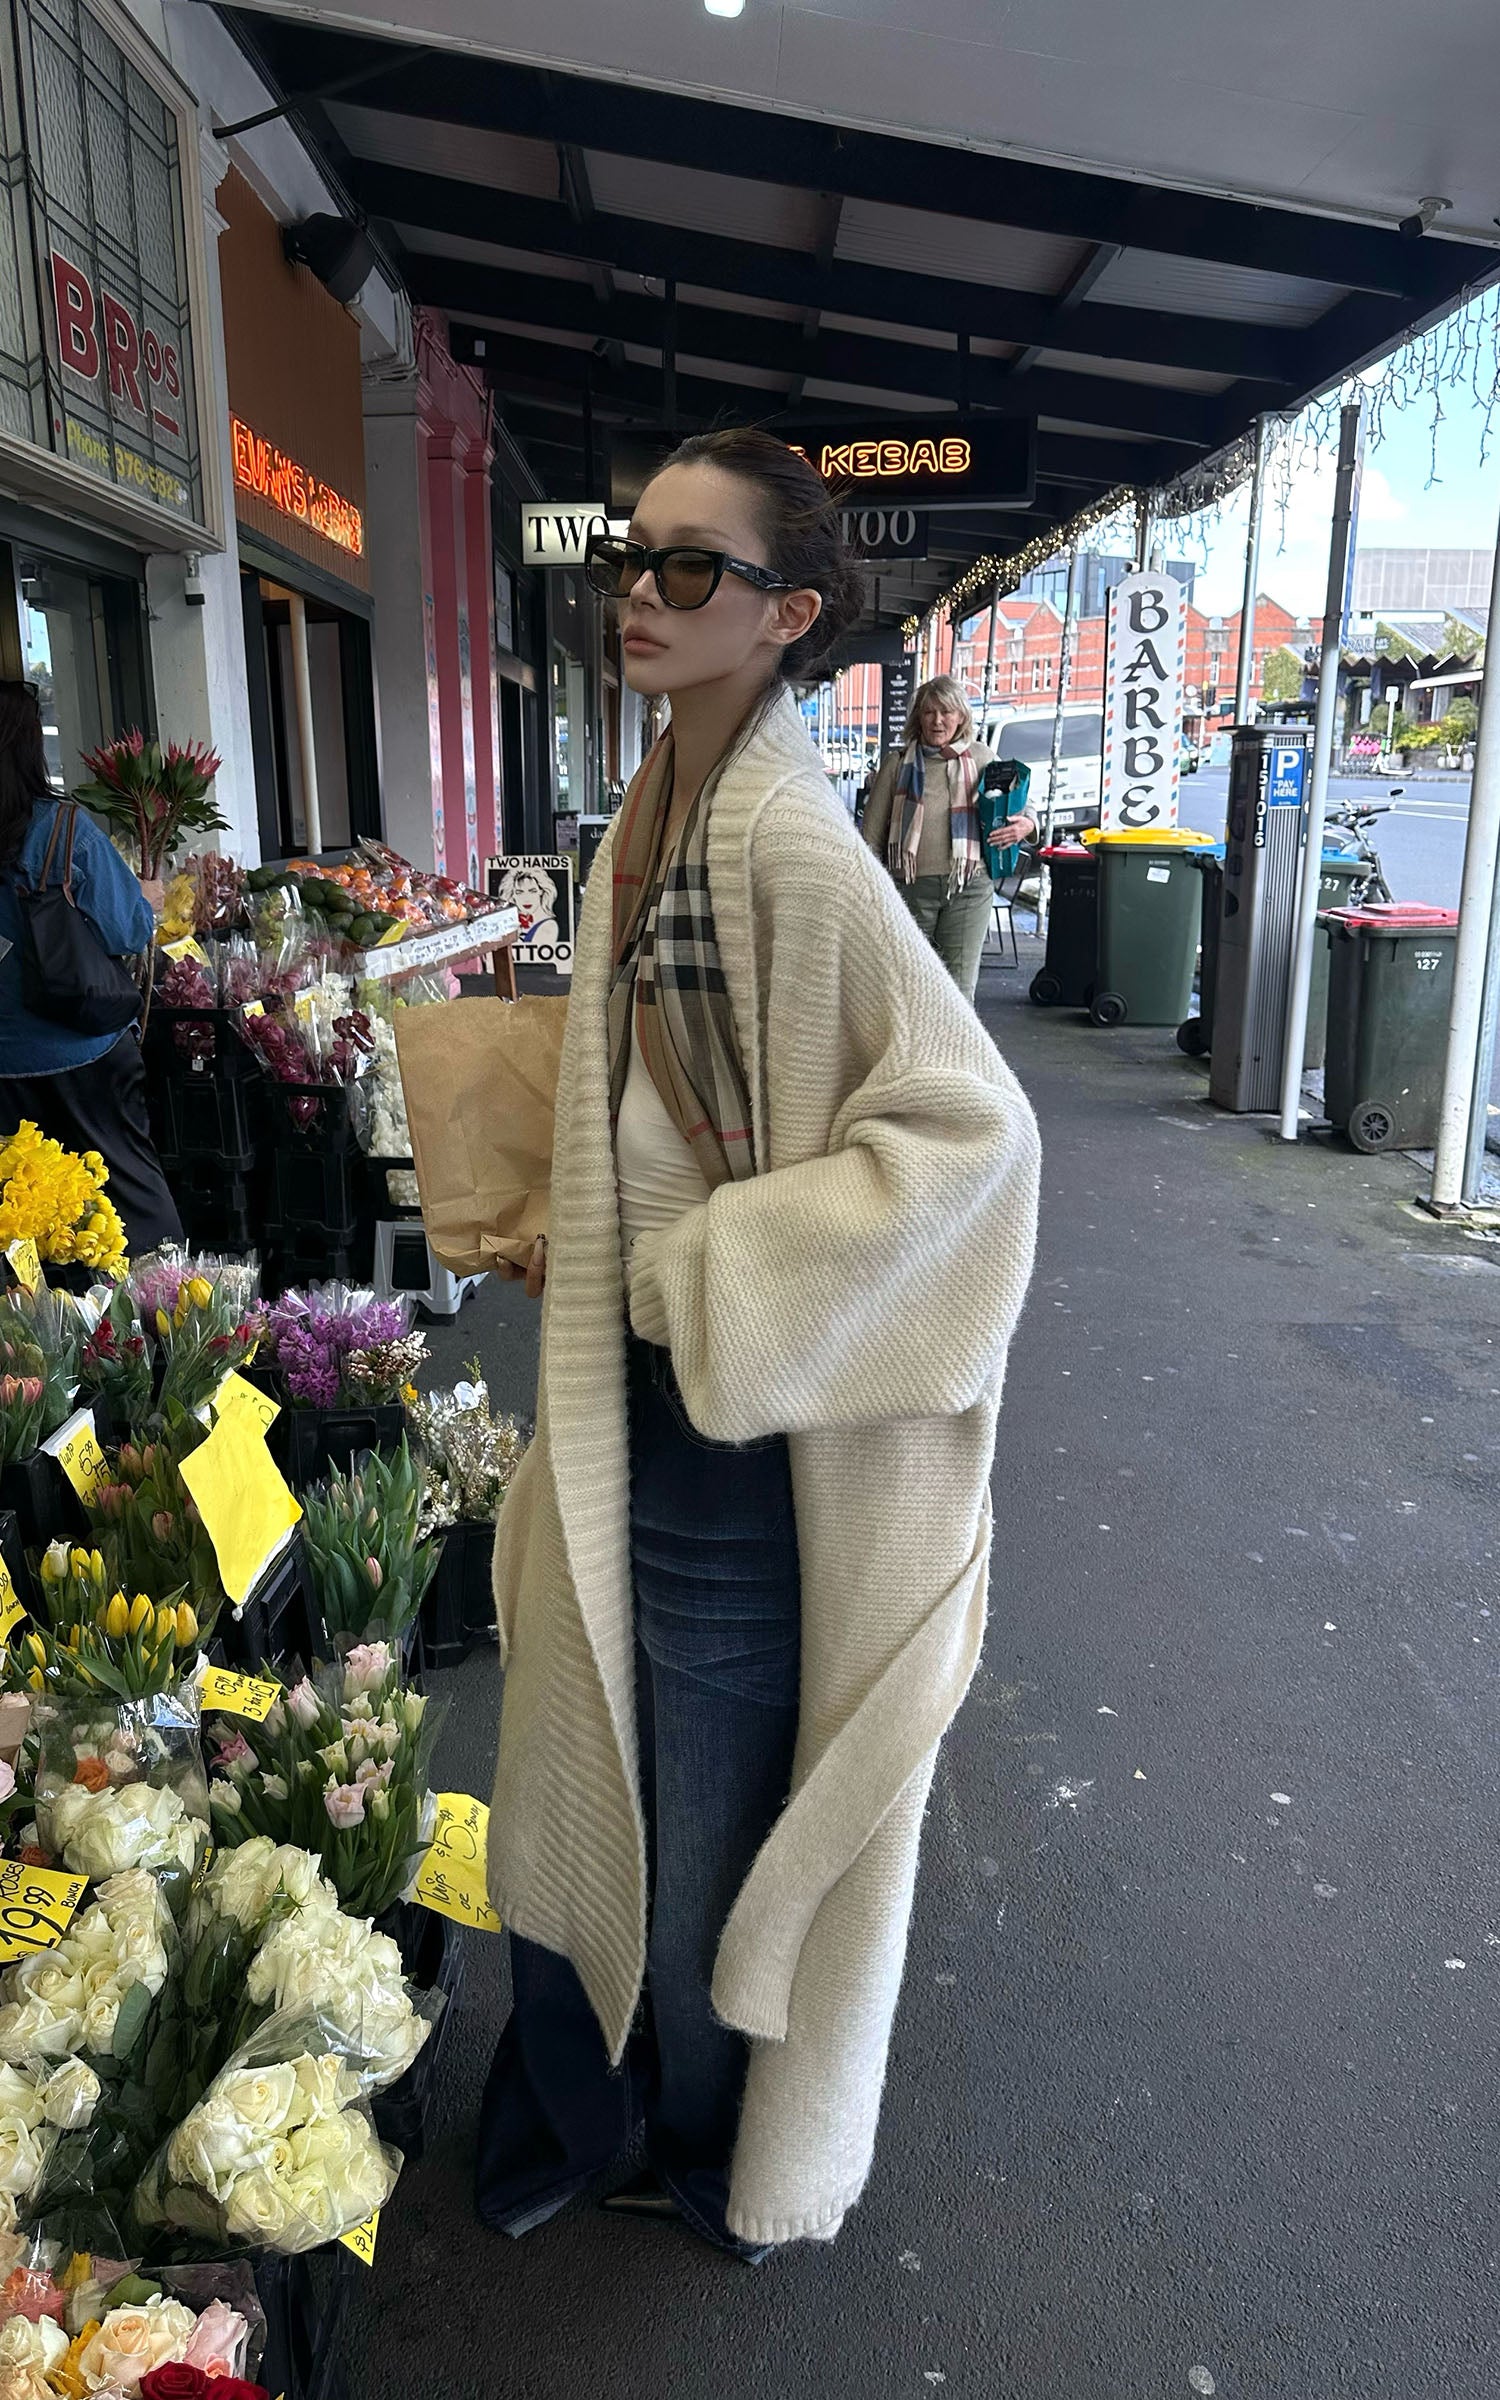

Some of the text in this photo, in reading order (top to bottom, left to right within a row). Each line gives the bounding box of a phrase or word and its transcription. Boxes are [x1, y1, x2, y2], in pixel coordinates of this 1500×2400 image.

[821, 438, 971, 478] KEBAB
[528, 516, 611, 553] TWO
[1276, 750, 1300, 778] P
[1273, 788, 1298, 797] HERE
[1277, 780, 1295, 788] PAY
[1254, 755, 1269, 847] 151016
[488, 857, 569, 868] TWO HANDS
[511, 944, 571, 961] TTOO
[1416, 959, 1440, 970] 127
